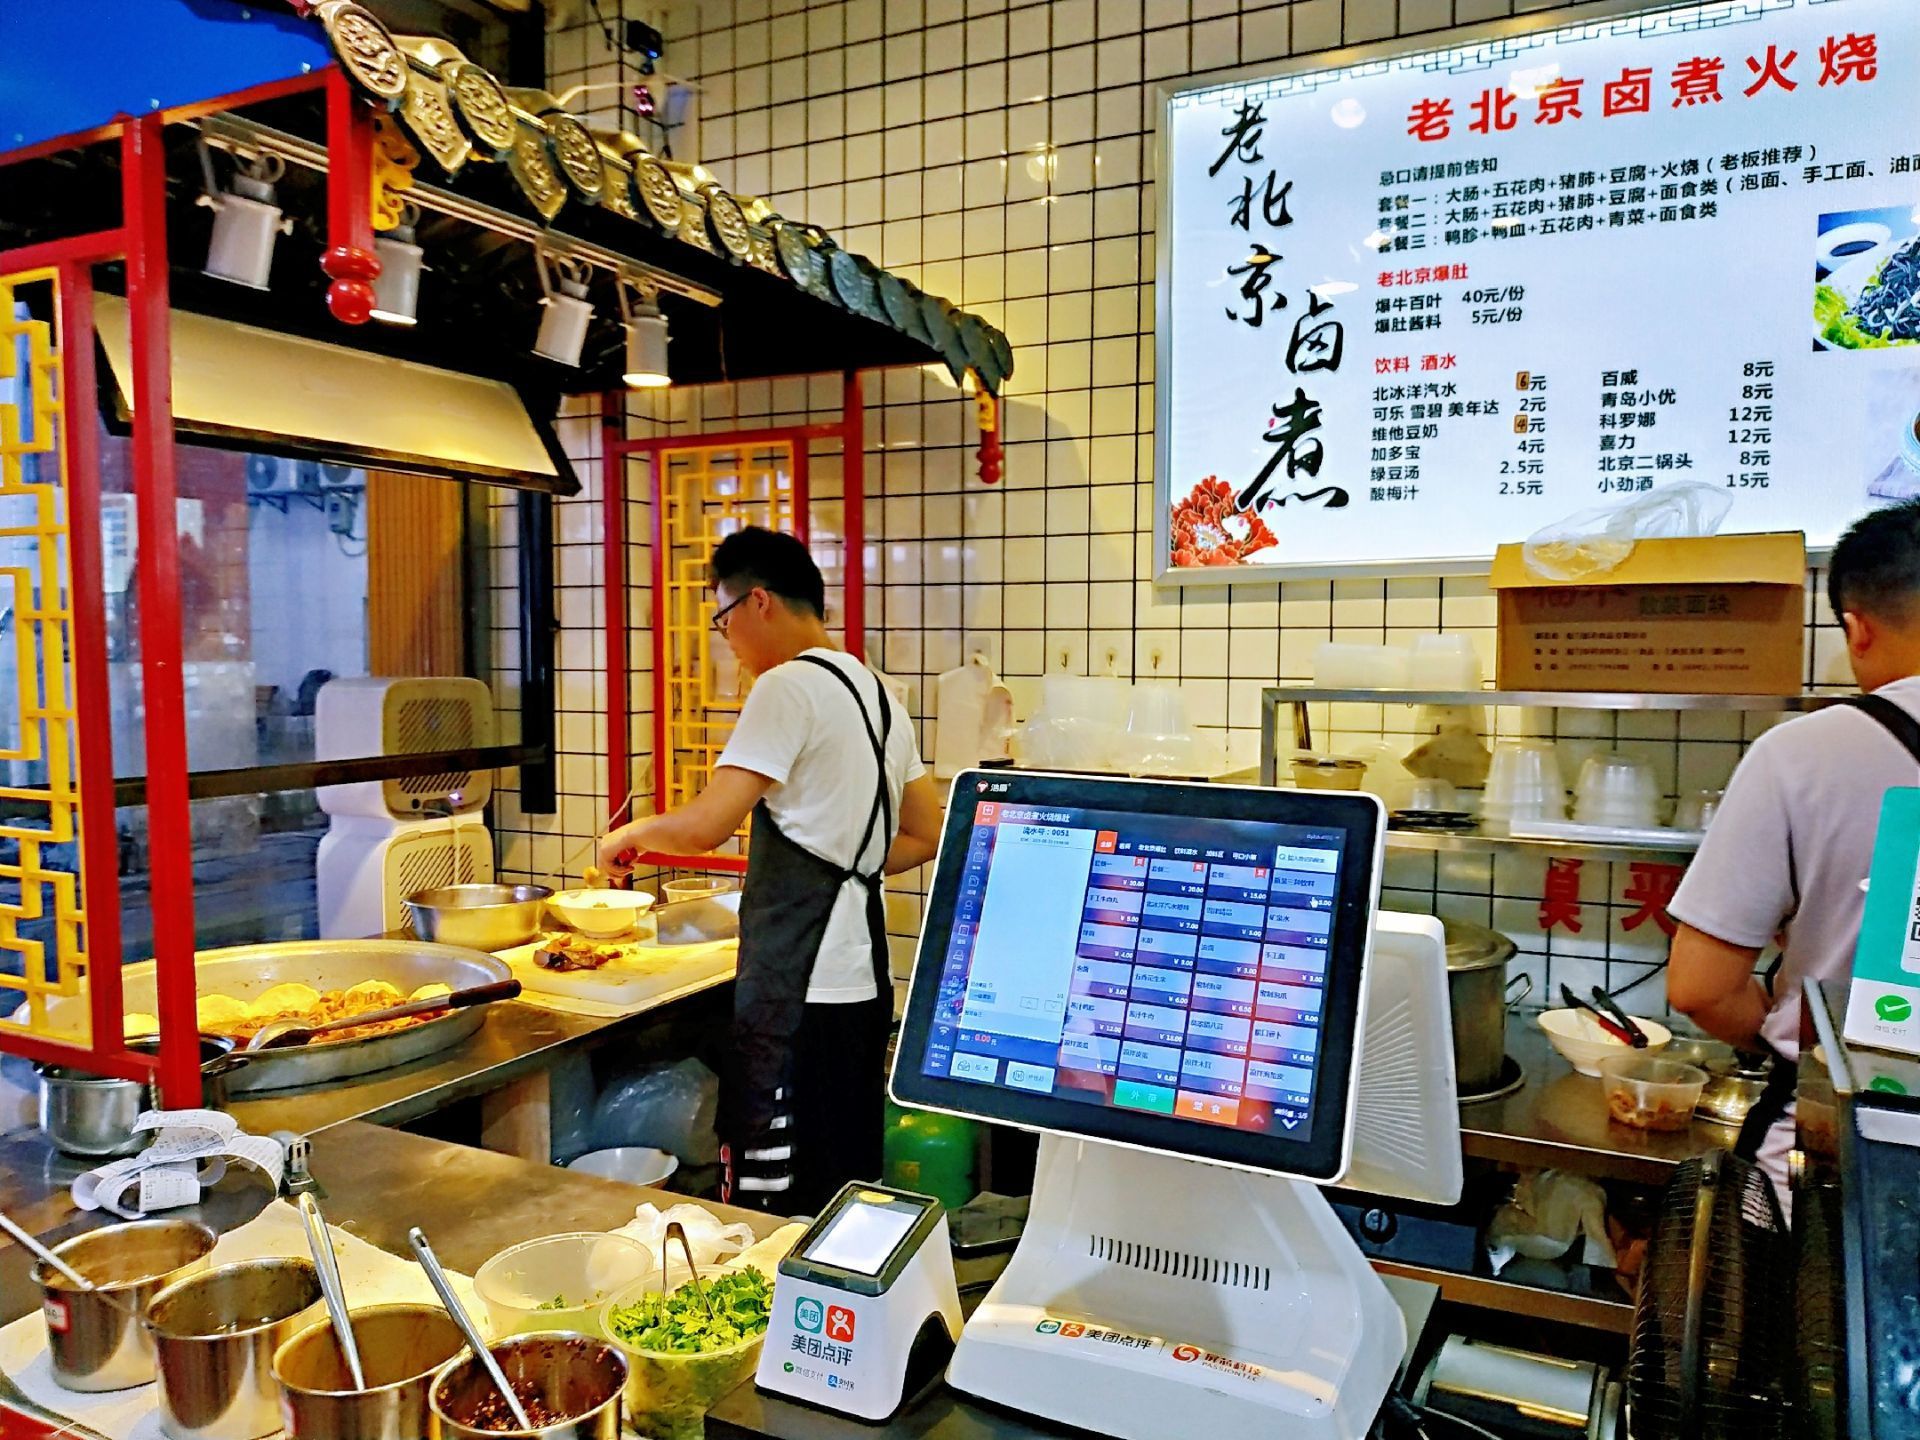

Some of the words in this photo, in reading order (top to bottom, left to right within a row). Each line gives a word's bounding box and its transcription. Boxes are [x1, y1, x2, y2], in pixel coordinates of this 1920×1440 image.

[1406, 32, 1879, 142] 老北京卤煮火烧
[1377, 263, 1469, 288] 老北京爆肚
[1375, 293, 1442, 314] 爆牛百叶
[1461, 285, 1525, 304] 40元/份
[1375, 314, 1442, 334] 爆肚酱料
[1472, 306, 1523, 325] 5元/份
[1375, 356, 1410, 374] 饮料
[1421, 353, 1457, 371] 酒水
[1601, 369, 1638, 387] 百威
[1743, 361, 1774, 377] 8元
[1373, 382, 1457, 401] 北冰洋汽水
[1600, 388, 1676, 408] 青岛小优
[1742, 383, 1773, 400] 8元
[1373, 405, 1404, 421] 可乐
[1410, 403, 1442, 419] 雪碧
[1448, 400, 1500, 417] 美年达
[1519, 396, 1547, 412] 2元
[1599, 411, 1656, 429] 科罗娜
[1729, 405, 1772, 422] 12元
[1371, 423, 1438, 441] 维他豆奶
[1599, 434, 1636, 451] 喜力
[1728, 427, 1771, 444] 12元
[1371, 445, 1420, 461] 加多宝
[1517, 438, 1545, 454] 4元
[1598, 453, 1693, 472] 北京二锅头
[1739, 450, 1771, 466] 8元
[1370, 465, 1419, 482] 绿豆汤
[1499, 459, 1544, 474] 2.5元
[1598, 475, 1653, 493] 小劲酒
[1726, 472, 1770, 488] 15元
[1370, 485, 1419, 502] 酸梅汁
[1499, 480, 1543, 495] 2.5元
[790, 1333, 853, 1367] 美团点评
[1084, 1328, 1153, 1350] 美团点评
